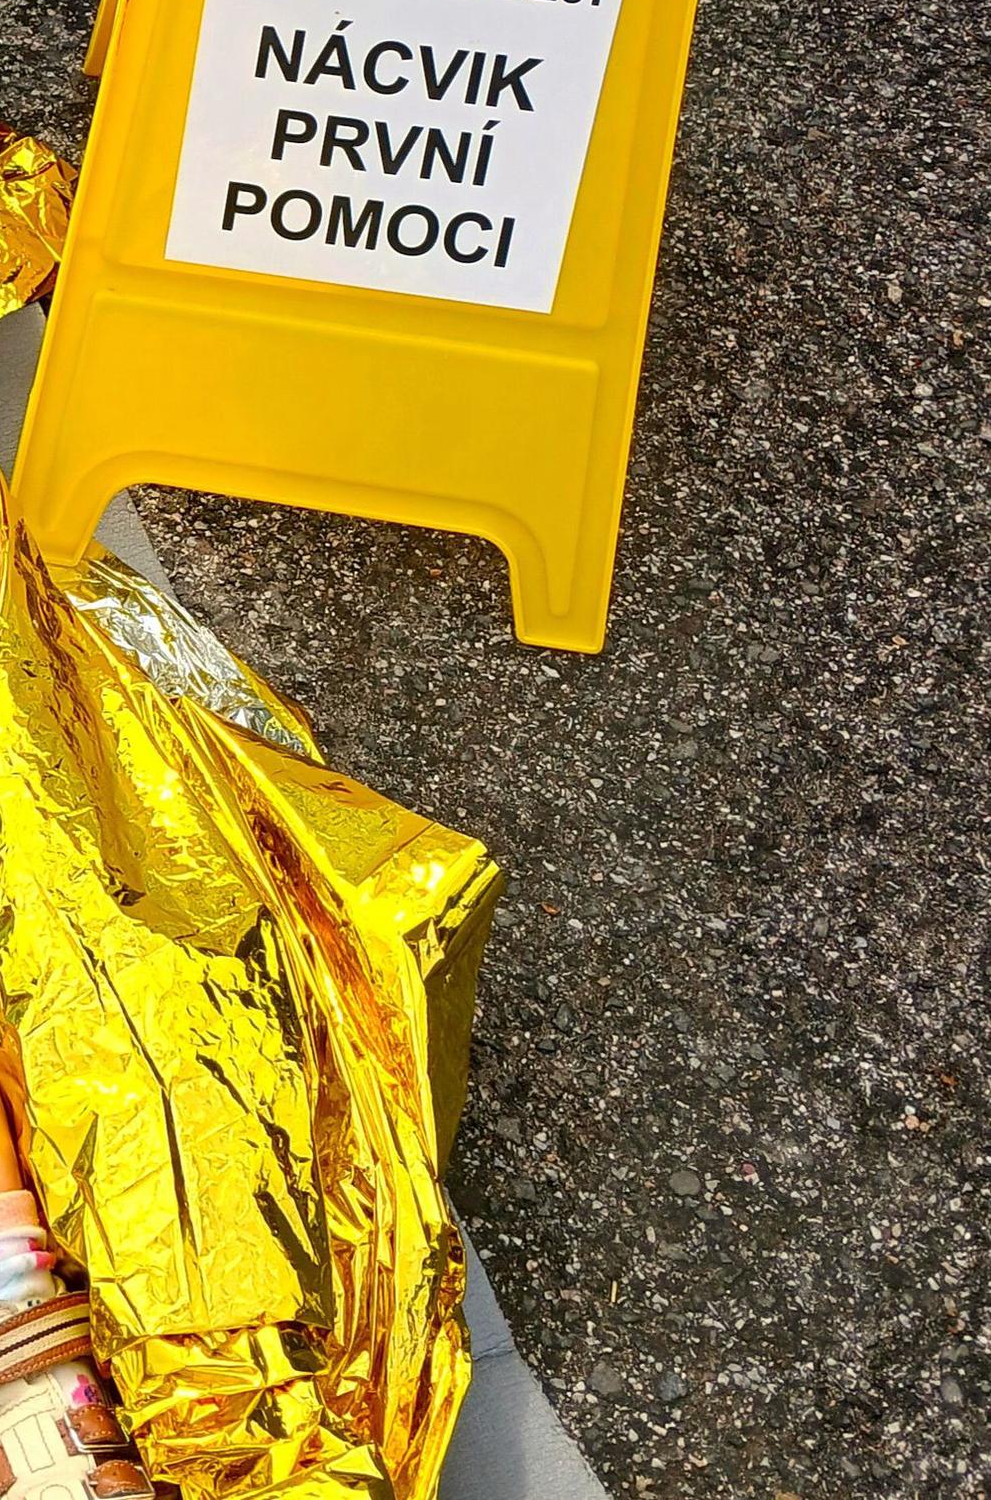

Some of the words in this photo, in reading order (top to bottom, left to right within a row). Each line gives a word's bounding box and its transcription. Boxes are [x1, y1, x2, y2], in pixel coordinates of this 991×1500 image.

[254, 19, 544, 112] NÁCVIK
[270, 108, 502, 187] PRVNÍ
[221, 180, 516, 268] POMOCI
